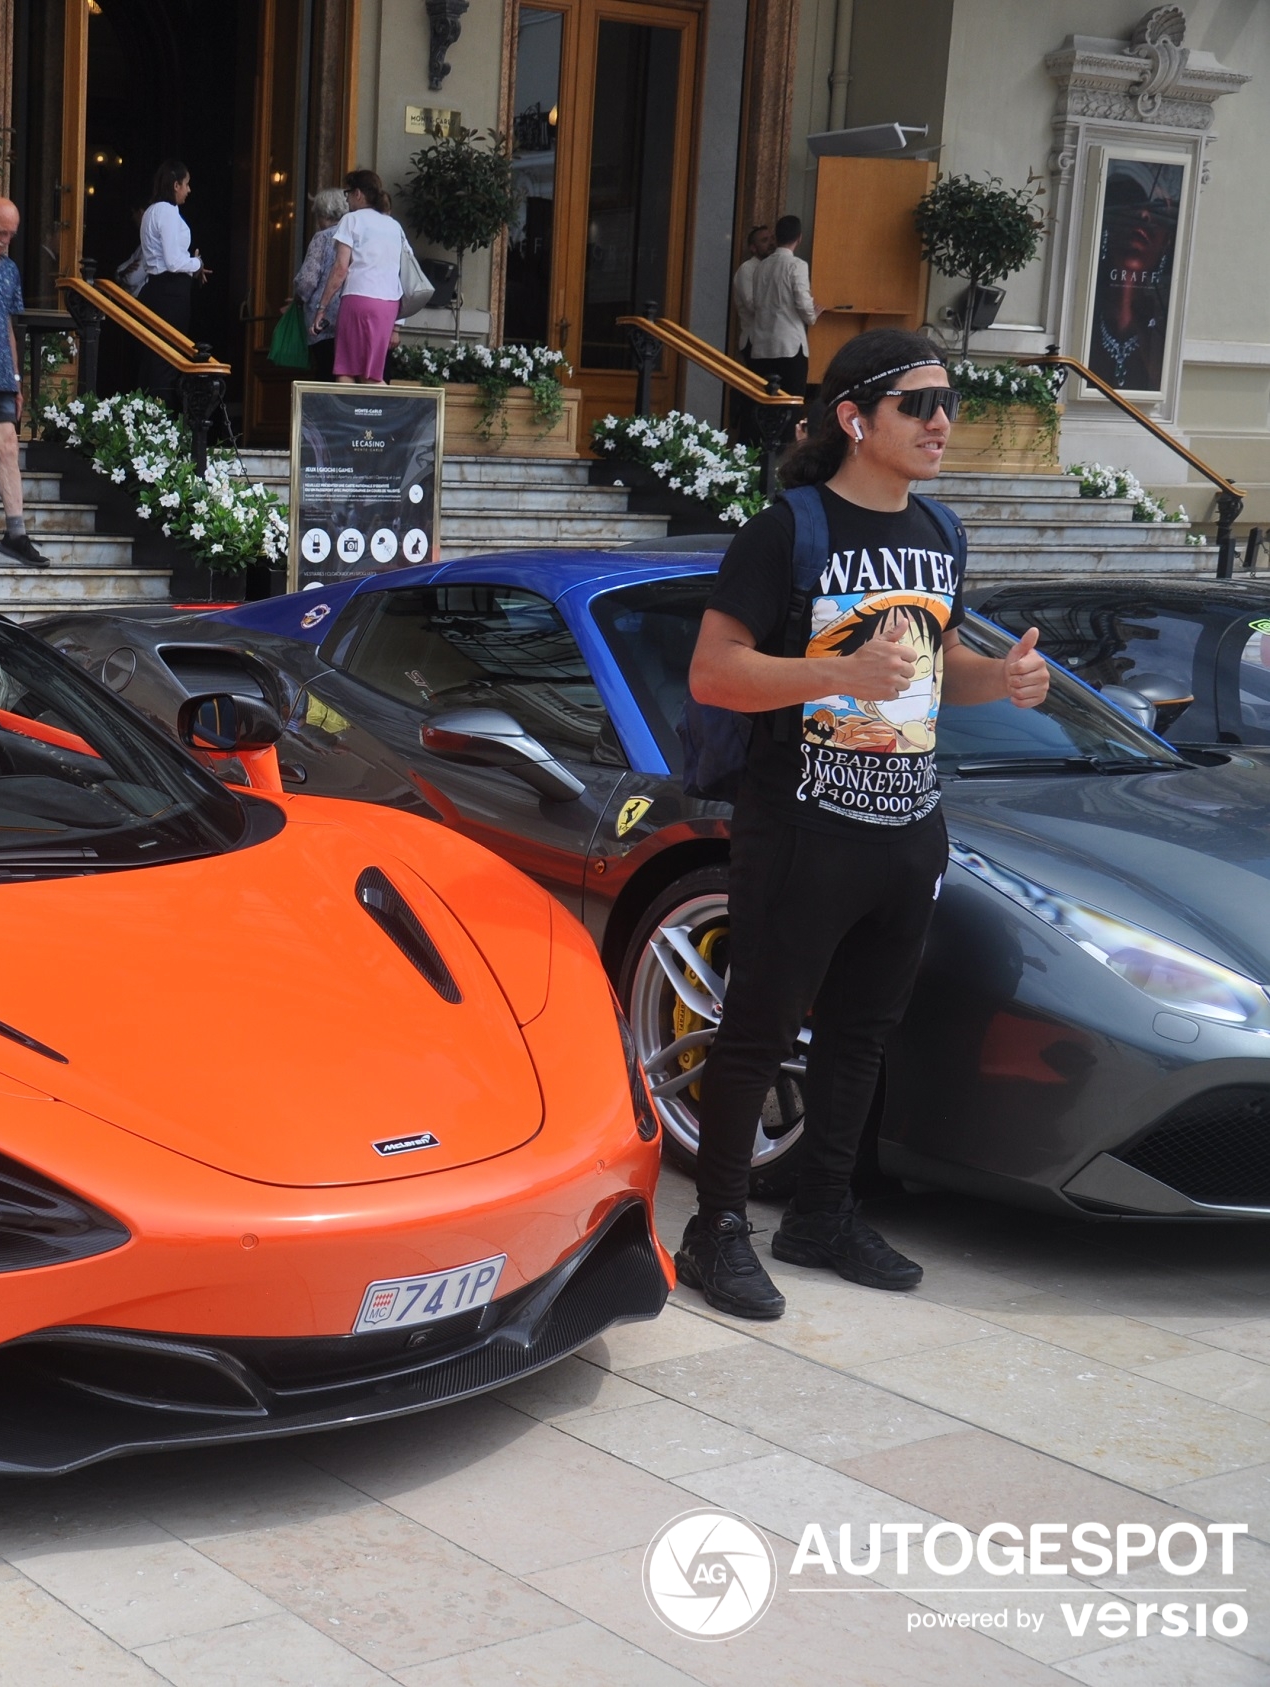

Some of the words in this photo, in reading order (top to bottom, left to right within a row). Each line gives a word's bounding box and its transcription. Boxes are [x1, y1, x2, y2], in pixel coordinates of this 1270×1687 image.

[1110, 268, 1157, 284] GRAFF
[360, 440, 385, 448] CASINO
[816, 748, 881, 769] DEAD
[886, 757, 911, 772] OR
[912, 789, 942, 821] MARINE
[383, 1138, 430, 1152] McLaren
[395, 1266, 496, 1322] 741P
[369, 1307, 387, 1319] MC
